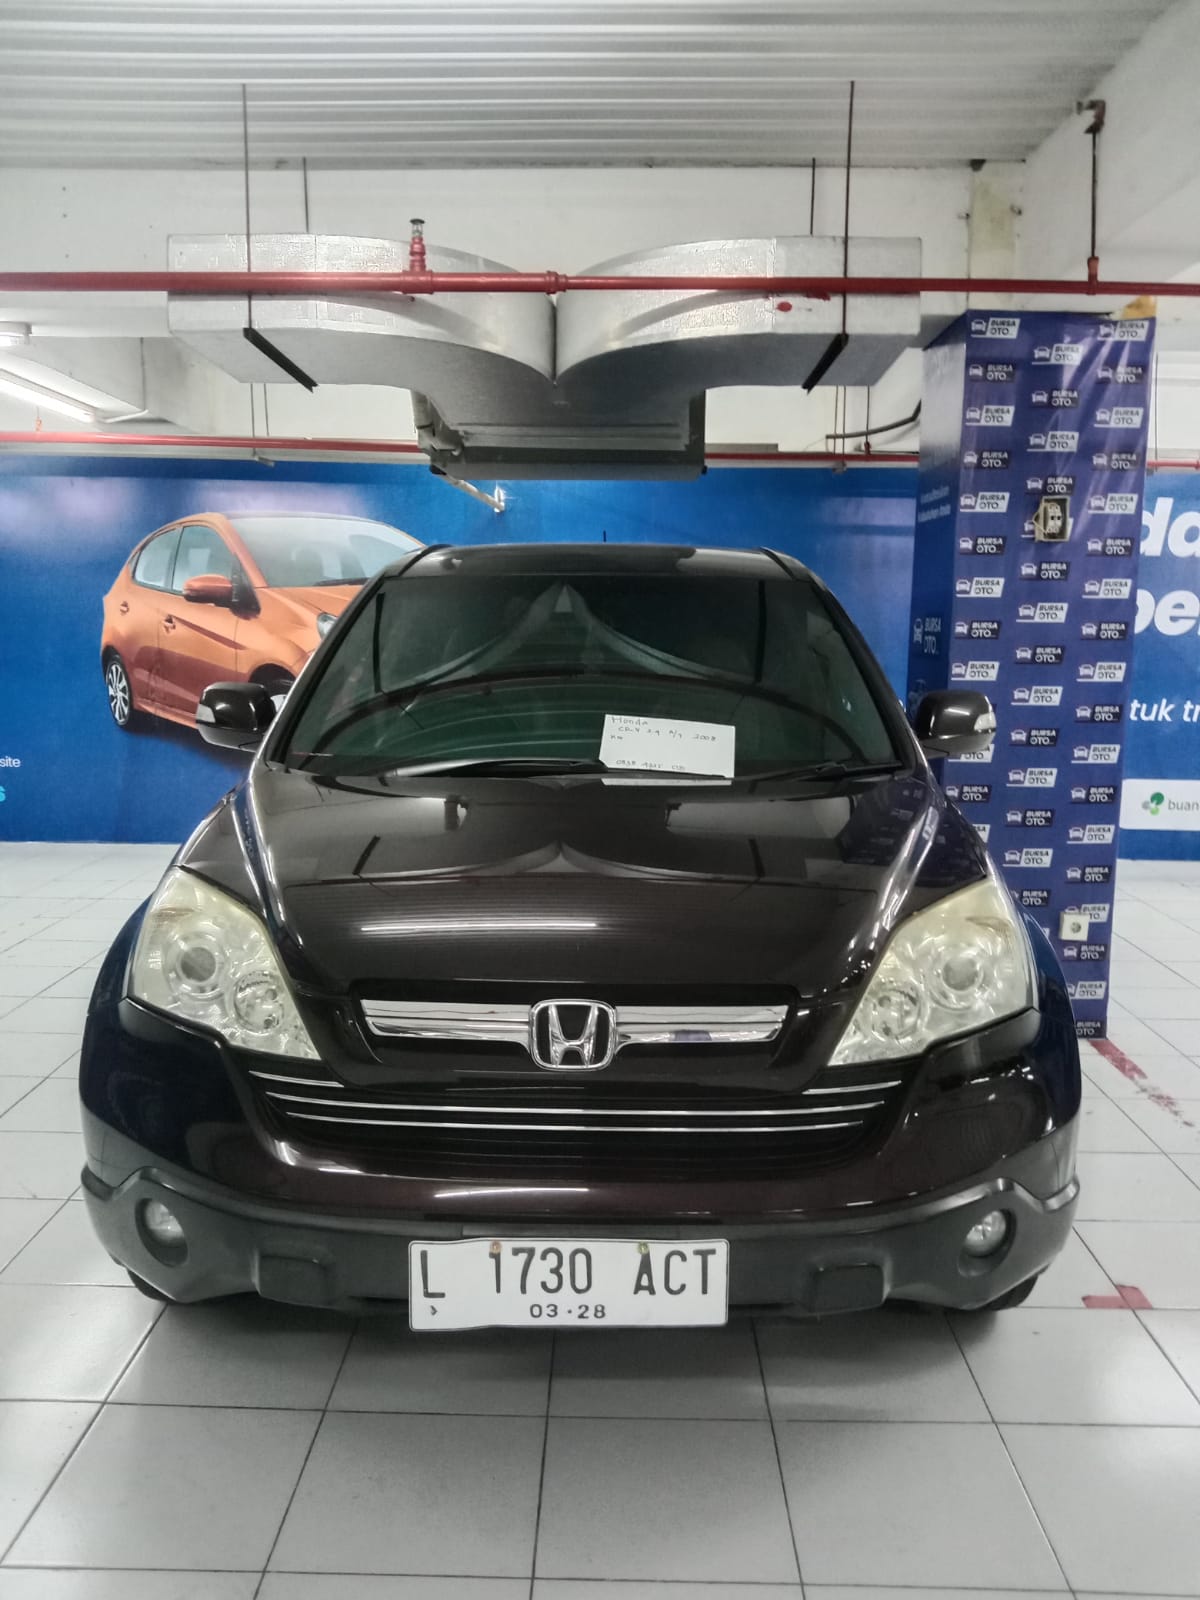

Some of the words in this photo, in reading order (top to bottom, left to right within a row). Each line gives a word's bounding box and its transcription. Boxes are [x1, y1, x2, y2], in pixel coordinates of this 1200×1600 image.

[990, 328, 1009, 336] OTO
[987, 364, 1013, 372] BURSA
[986, 372, 1006, 380] OTO
[1052, 390, 1078, 398] BURSA
[1051, 398, 1072, 406] OTO
[986, 406, 1010, 414] BURSA
[1115, 408, 1140, 417] BURSA
[984, 414, 1004, 423] OTO
[1114, 417, 1134, 425] OTO
[1050, 441, 1069, 449] OTO
[982, 452, 1008, 460] BURSA
[982, 459, 1001, 467] OTO
[1111, 460, 1131, 469] OTO
[1047, 477, 1072, 485] BURSA
[1047, 484, 1067, 493] OTO
[981, 493, 1005, 502] BURSA
[979, 501, 999, 510] OTO
[1108, 502, 1128, 511] OTO
[977, 538, 1003, 546] BURSA
[1106, 539, 1131, 547] BURSA
[976, 544, 997, 553] OTO
[1105, 546, 1125, 555] OTO
[1041, 563, 1066, 571] BURSA
[1040, 570, 1060, 579] OTO
[975, 579, 1000, 587] BURSA
[974, 587, 993, 595] OTO
[1103, 587, 1123, 596] OTO
[1038, 612, 1058, 620] OTO
[972, 622, 997, 630] BURSA
[1100, 623, 1125, 631] BURSA
[971, 629, 991, 637] OTO
[1100, 629, 1119, 638] OTO
[1036, 648, 1062, 656] BURSA
[1035, 654, 1055, 663] OTO
[970, 663, 995, 671] BURSA
[1098, 664, 1122, 672] BURSA
[969, 670, 989, 678] OTO
[1098, 671, 1117, 679] OTO
[1033, 688, 1058, 696] BURSA
[1033, 695, 1052, 703] OTO
[1095, 706, 1119, 714] BURSA
[1129, 698, 1175, 721] tuk
[1094, 712, 1114, 721] OTO
[1030, 729, 1056, 737] BURSA
[1030, 736, 1050, 745] OTO
[1092, 746, 1116, 754] BURSA
[964, 752, 984, 760] OTO
[1091, 753, 1110, 761] OTO
[1028, 777, 1048, 785] OTO
[1089, 787, 1114, 795] BURSA
[1089, 793, 1109, 802] OTO
[1026, 817, 1045, 826] OTO
[1024, 850, 1049, 858] BURSA
[1085, 867, 1109, 875] BURSA
[1084, 874, 1103, 882] OTO
[1022, 897, 1042, 905] OTO
[1082, 905, 1106, 913] BURSA
[1080, 945, 1105, 953] BURSA
[1080, 952, 1099, 960] OTO
[1079, 989, 1097, 997] OTO
[1075, 1028, 1095, 1036] OTO
[420, 1250, 446, 1299] L
[488, 1246, 592, 1295] 1730
[633, 1248, 716, 1296] ACT
